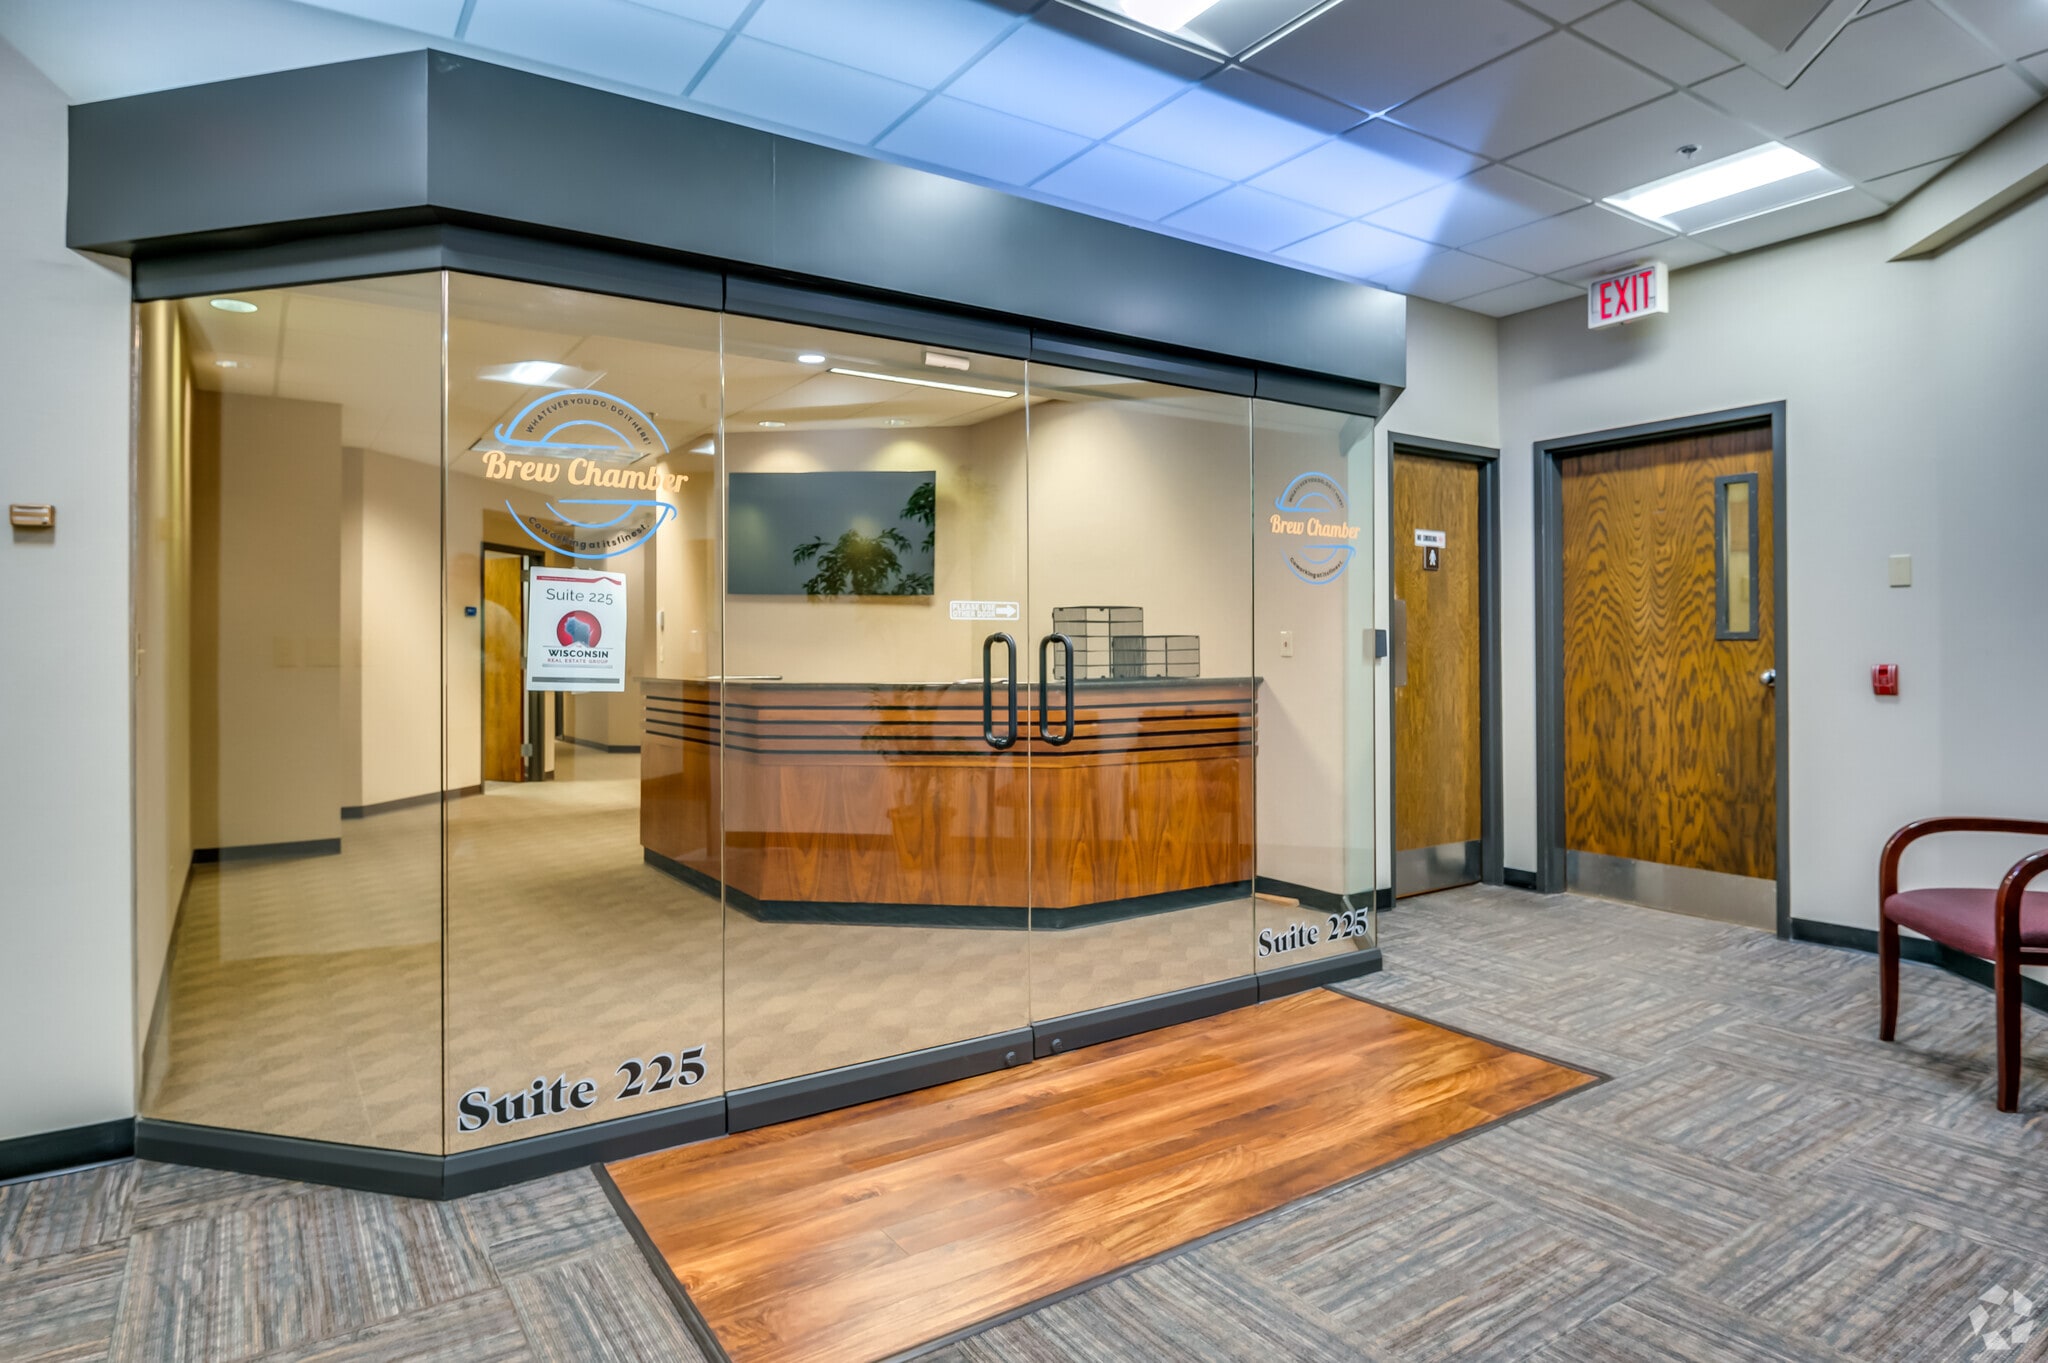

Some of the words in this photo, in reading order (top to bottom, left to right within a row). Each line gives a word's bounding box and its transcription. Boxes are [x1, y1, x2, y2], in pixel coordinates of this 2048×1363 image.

[1600, 269, 1653, 320] EXIT
[482, 450, 560, 483] Brew
[567, 457, 689, 493] Chamber
[1270, 513, 1304, 535] Brew
[1306, 517, 1361, 539] Chamber
[546, 588, 585, 602] Suite
[588, 593, 613, 606] 225
[548, 649, 609, 659] WISCONSIN
[1258, 921, 1319, 958] Suite
[1326, 906, 1369, 941] 225
[457, 1073, 597, 1133] Suite
[615, 1043, 708, 1101] 225
